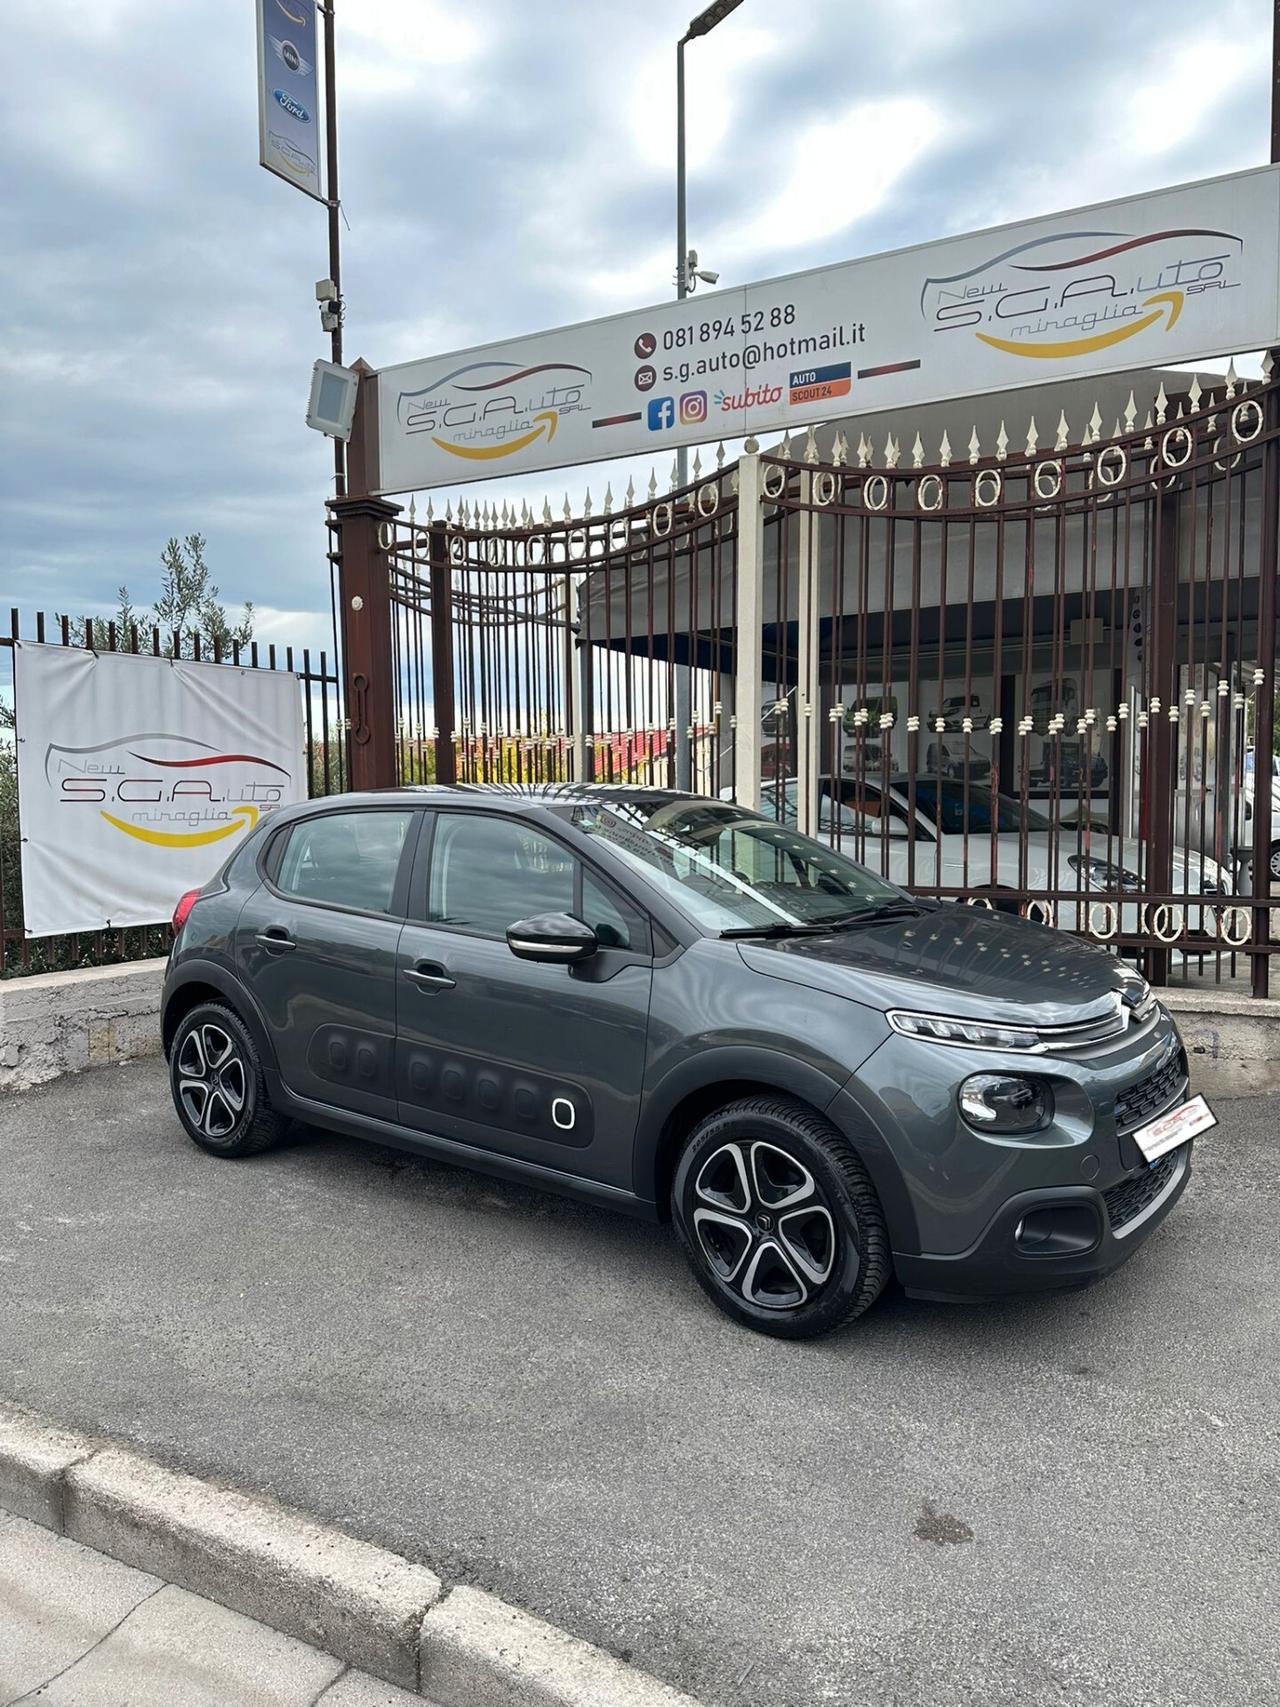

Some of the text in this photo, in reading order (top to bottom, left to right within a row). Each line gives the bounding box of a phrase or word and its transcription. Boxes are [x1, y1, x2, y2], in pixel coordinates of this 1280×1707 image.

[279, 93, 305, 119] Ford
[937, 281, 1009, 305] New
[663, 304, 796, 351] 081 894 52 88
[1010, 304, 1146, 338] miraglia
[662, 322, 866, 383] s.g.auto@hotmail.it
[791, 372, 816, 386] AUTO
[406, 397, 451, 413] New
[720, 384, 784, 412] subito
[792, 385, 833, 401] SCOUT 24
[453, 419, 536, 443] miraglia
[57, 759, 126, 775] New
[131, 807, 233, 827] miraglia
